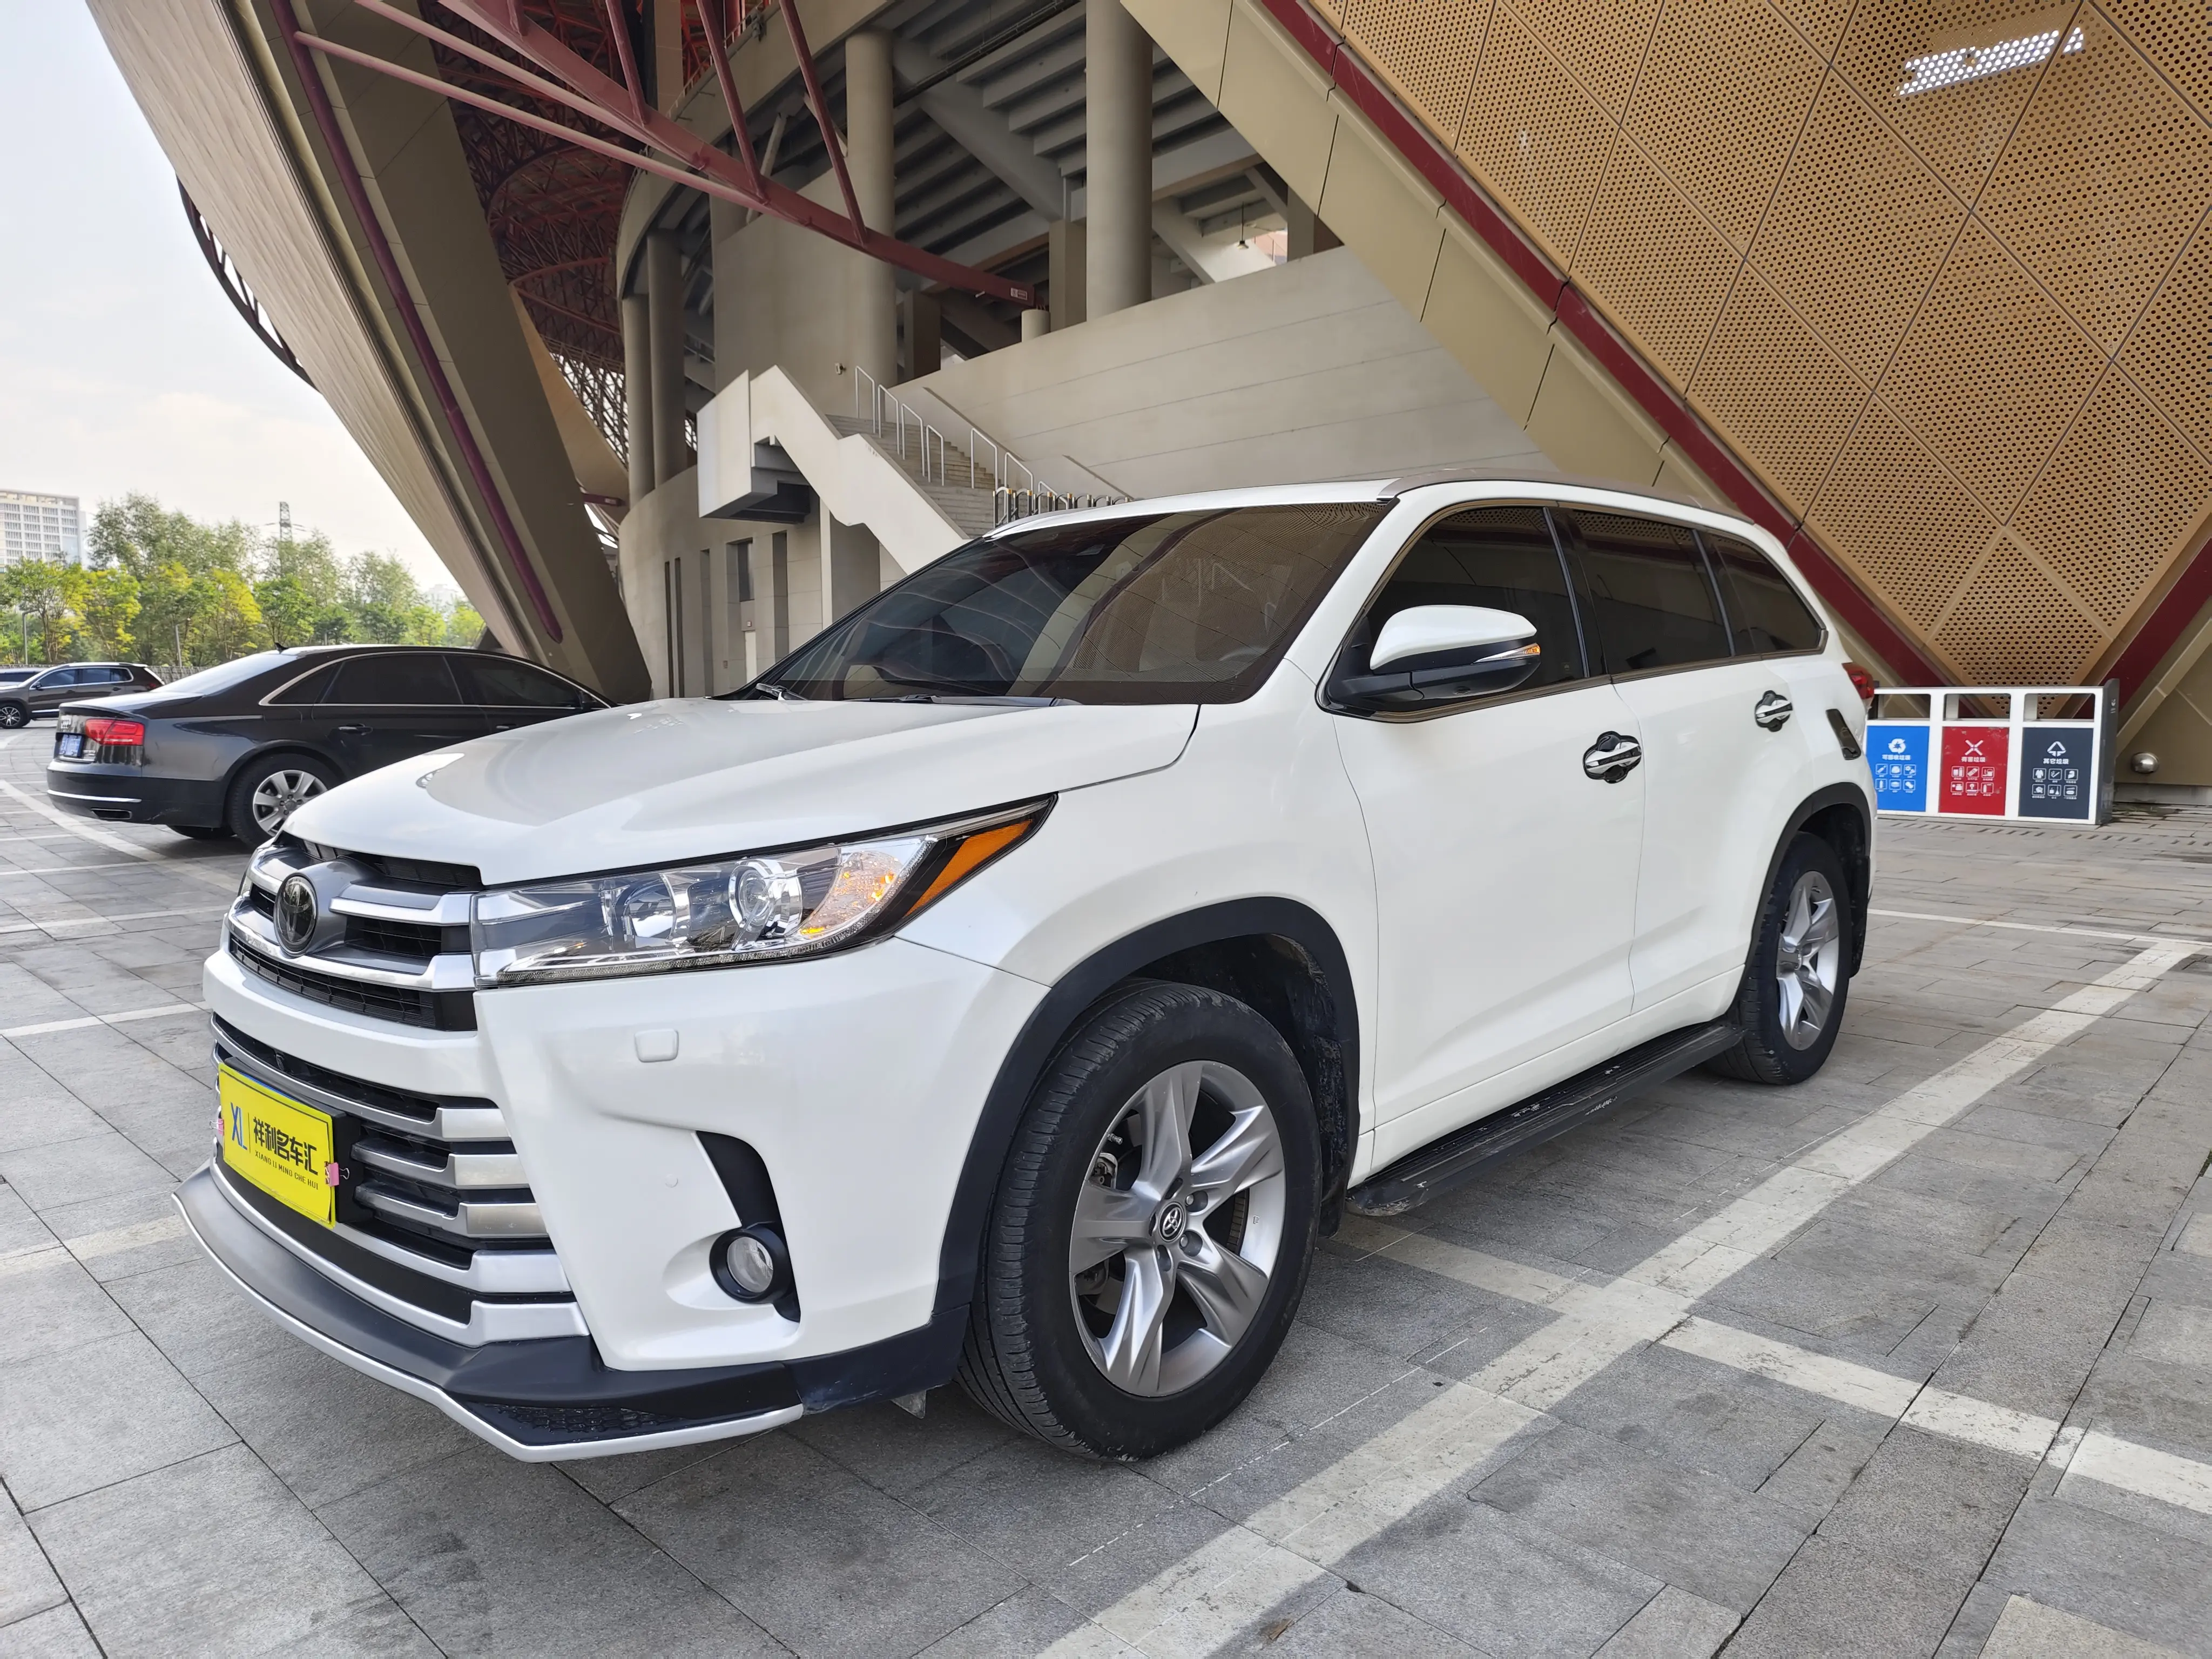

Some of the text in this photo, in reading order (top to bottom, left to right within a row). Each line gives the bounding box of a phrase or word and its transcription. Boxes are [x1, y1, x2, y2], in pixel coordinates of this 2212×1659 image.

[231, 1102, 247, 1150] XL
[253, 1116, 318, 1176] 祥利名车汇
[255, 1150, 319, 1190] XIANG LI MING CHE HUI
